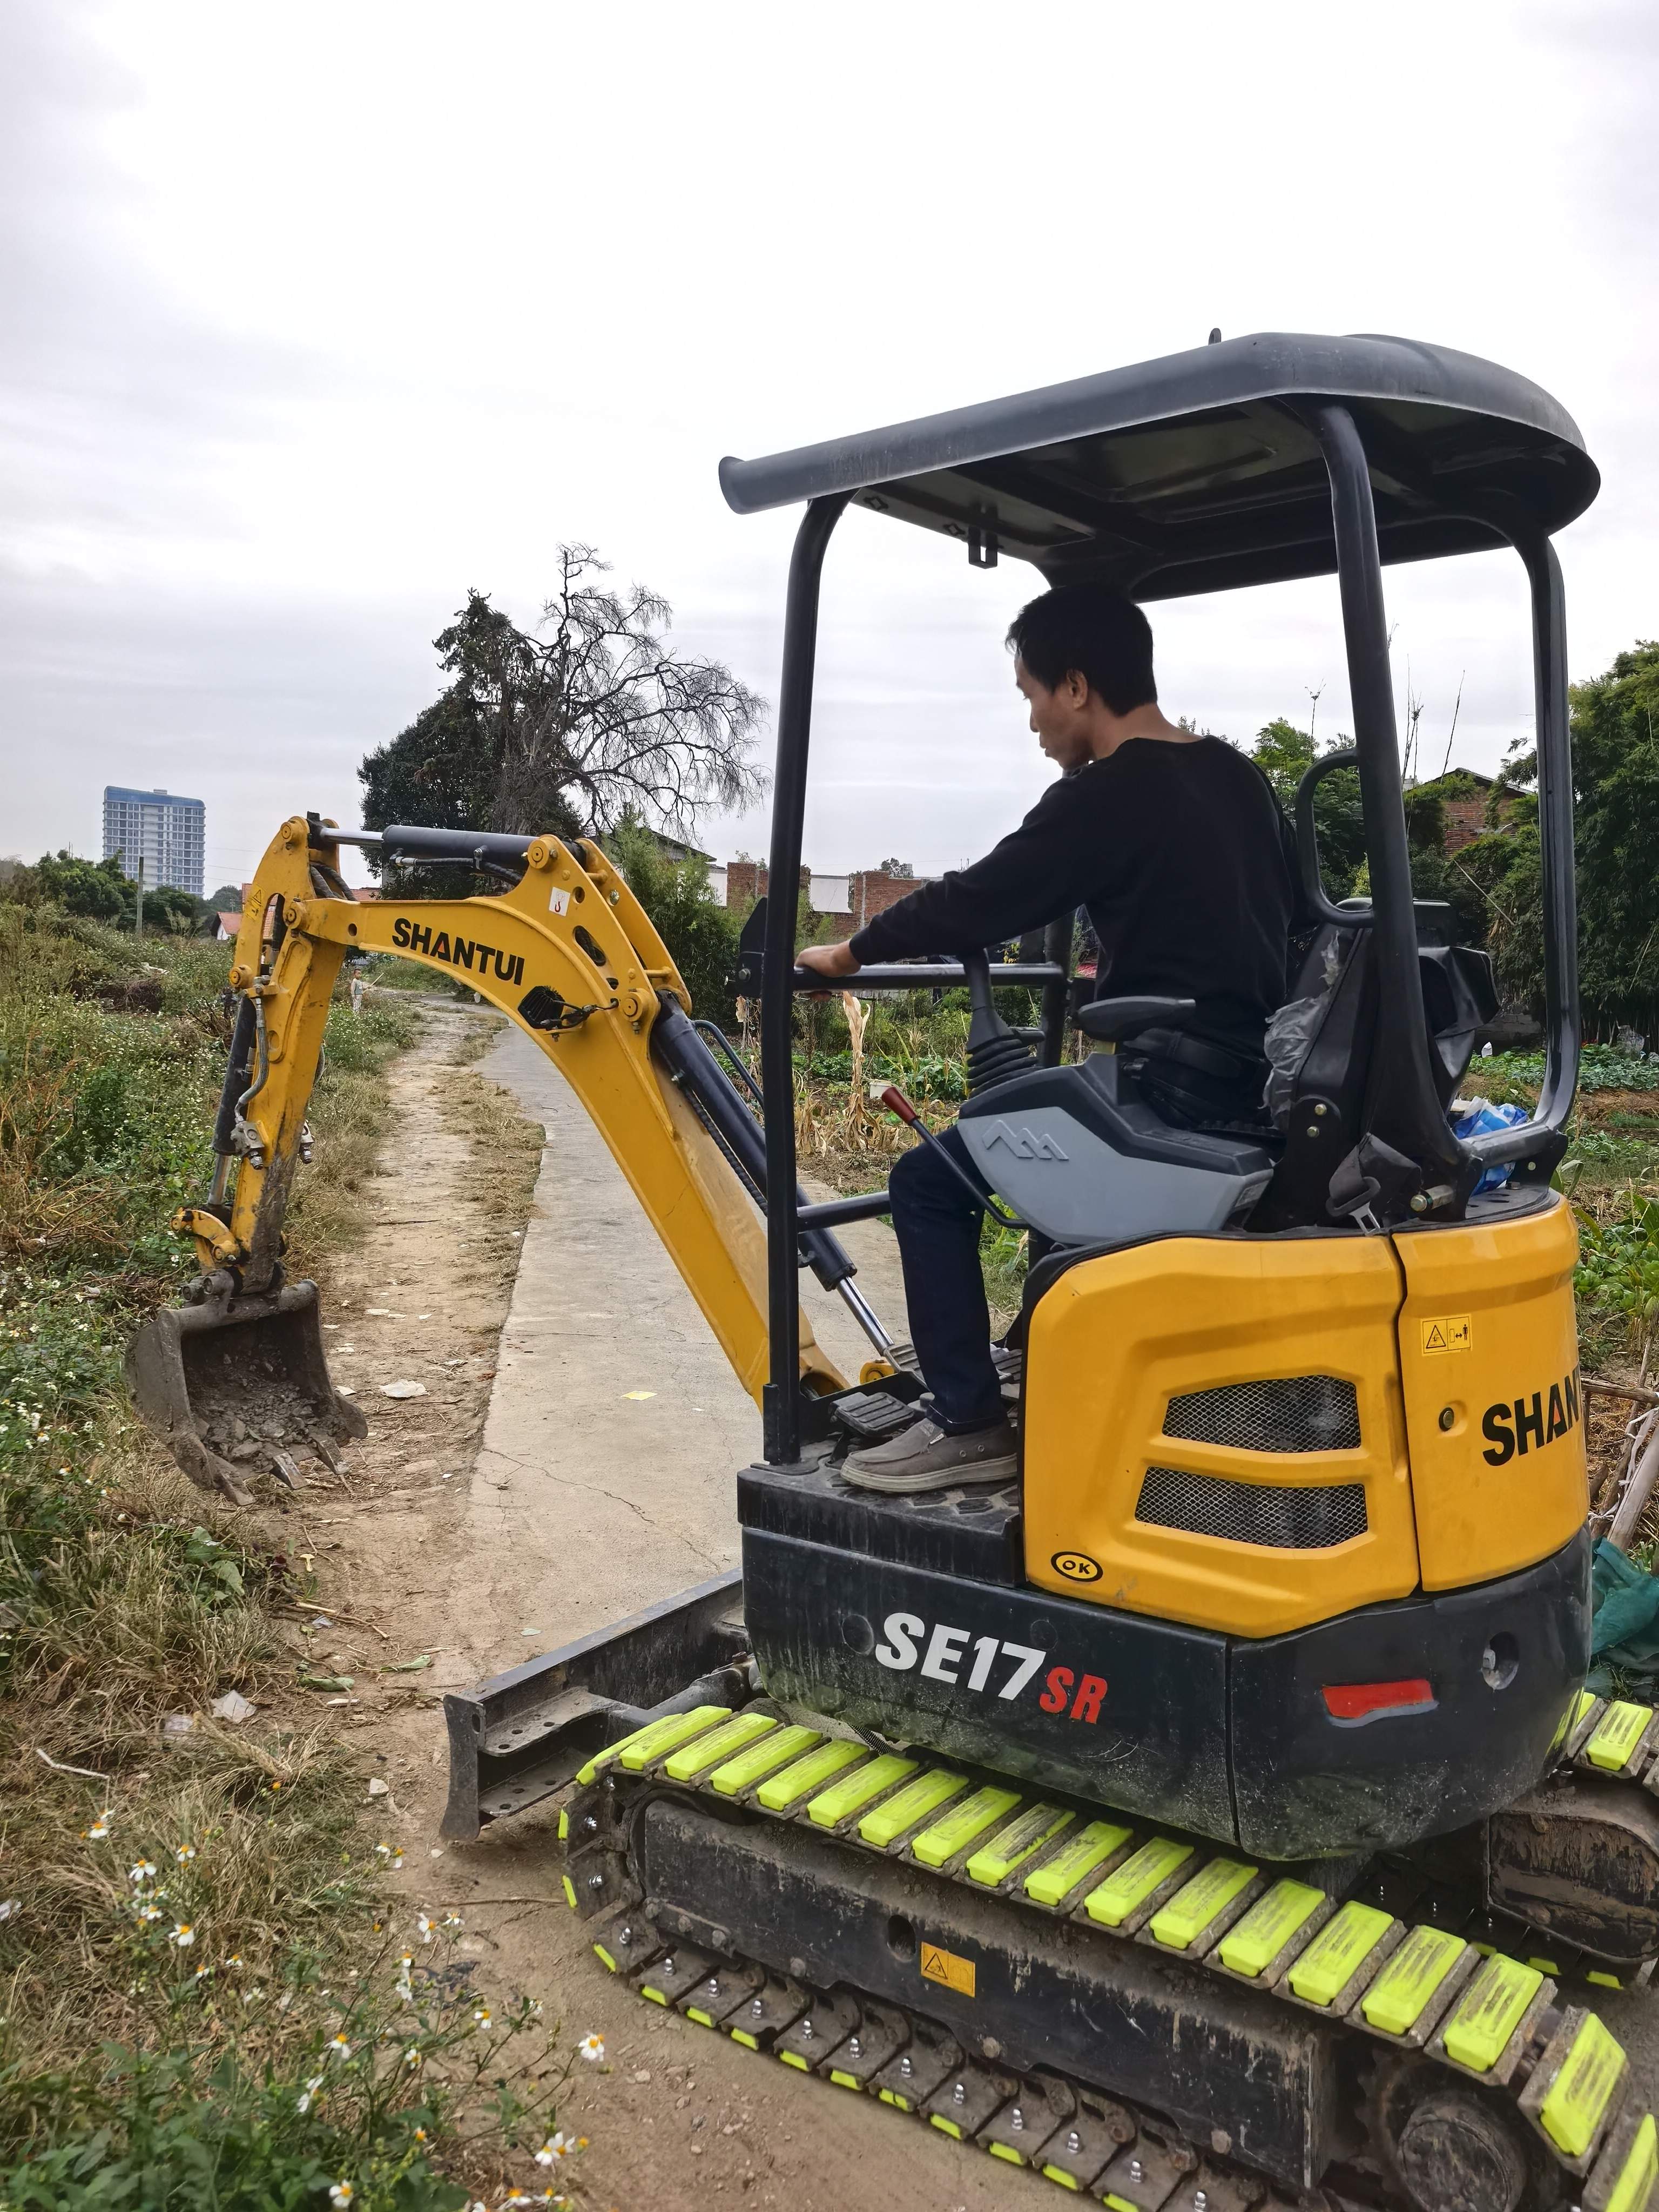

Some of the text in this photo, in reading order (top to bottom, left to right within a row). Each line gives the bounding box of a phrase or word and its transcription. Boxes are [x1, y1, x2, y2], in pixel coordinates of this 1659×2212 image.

[392, 918, 524, 986] SHANTUI
[1482, 1365, 1580, 1466] SHAN
[1062, 1560, 1090, 1574] OK
